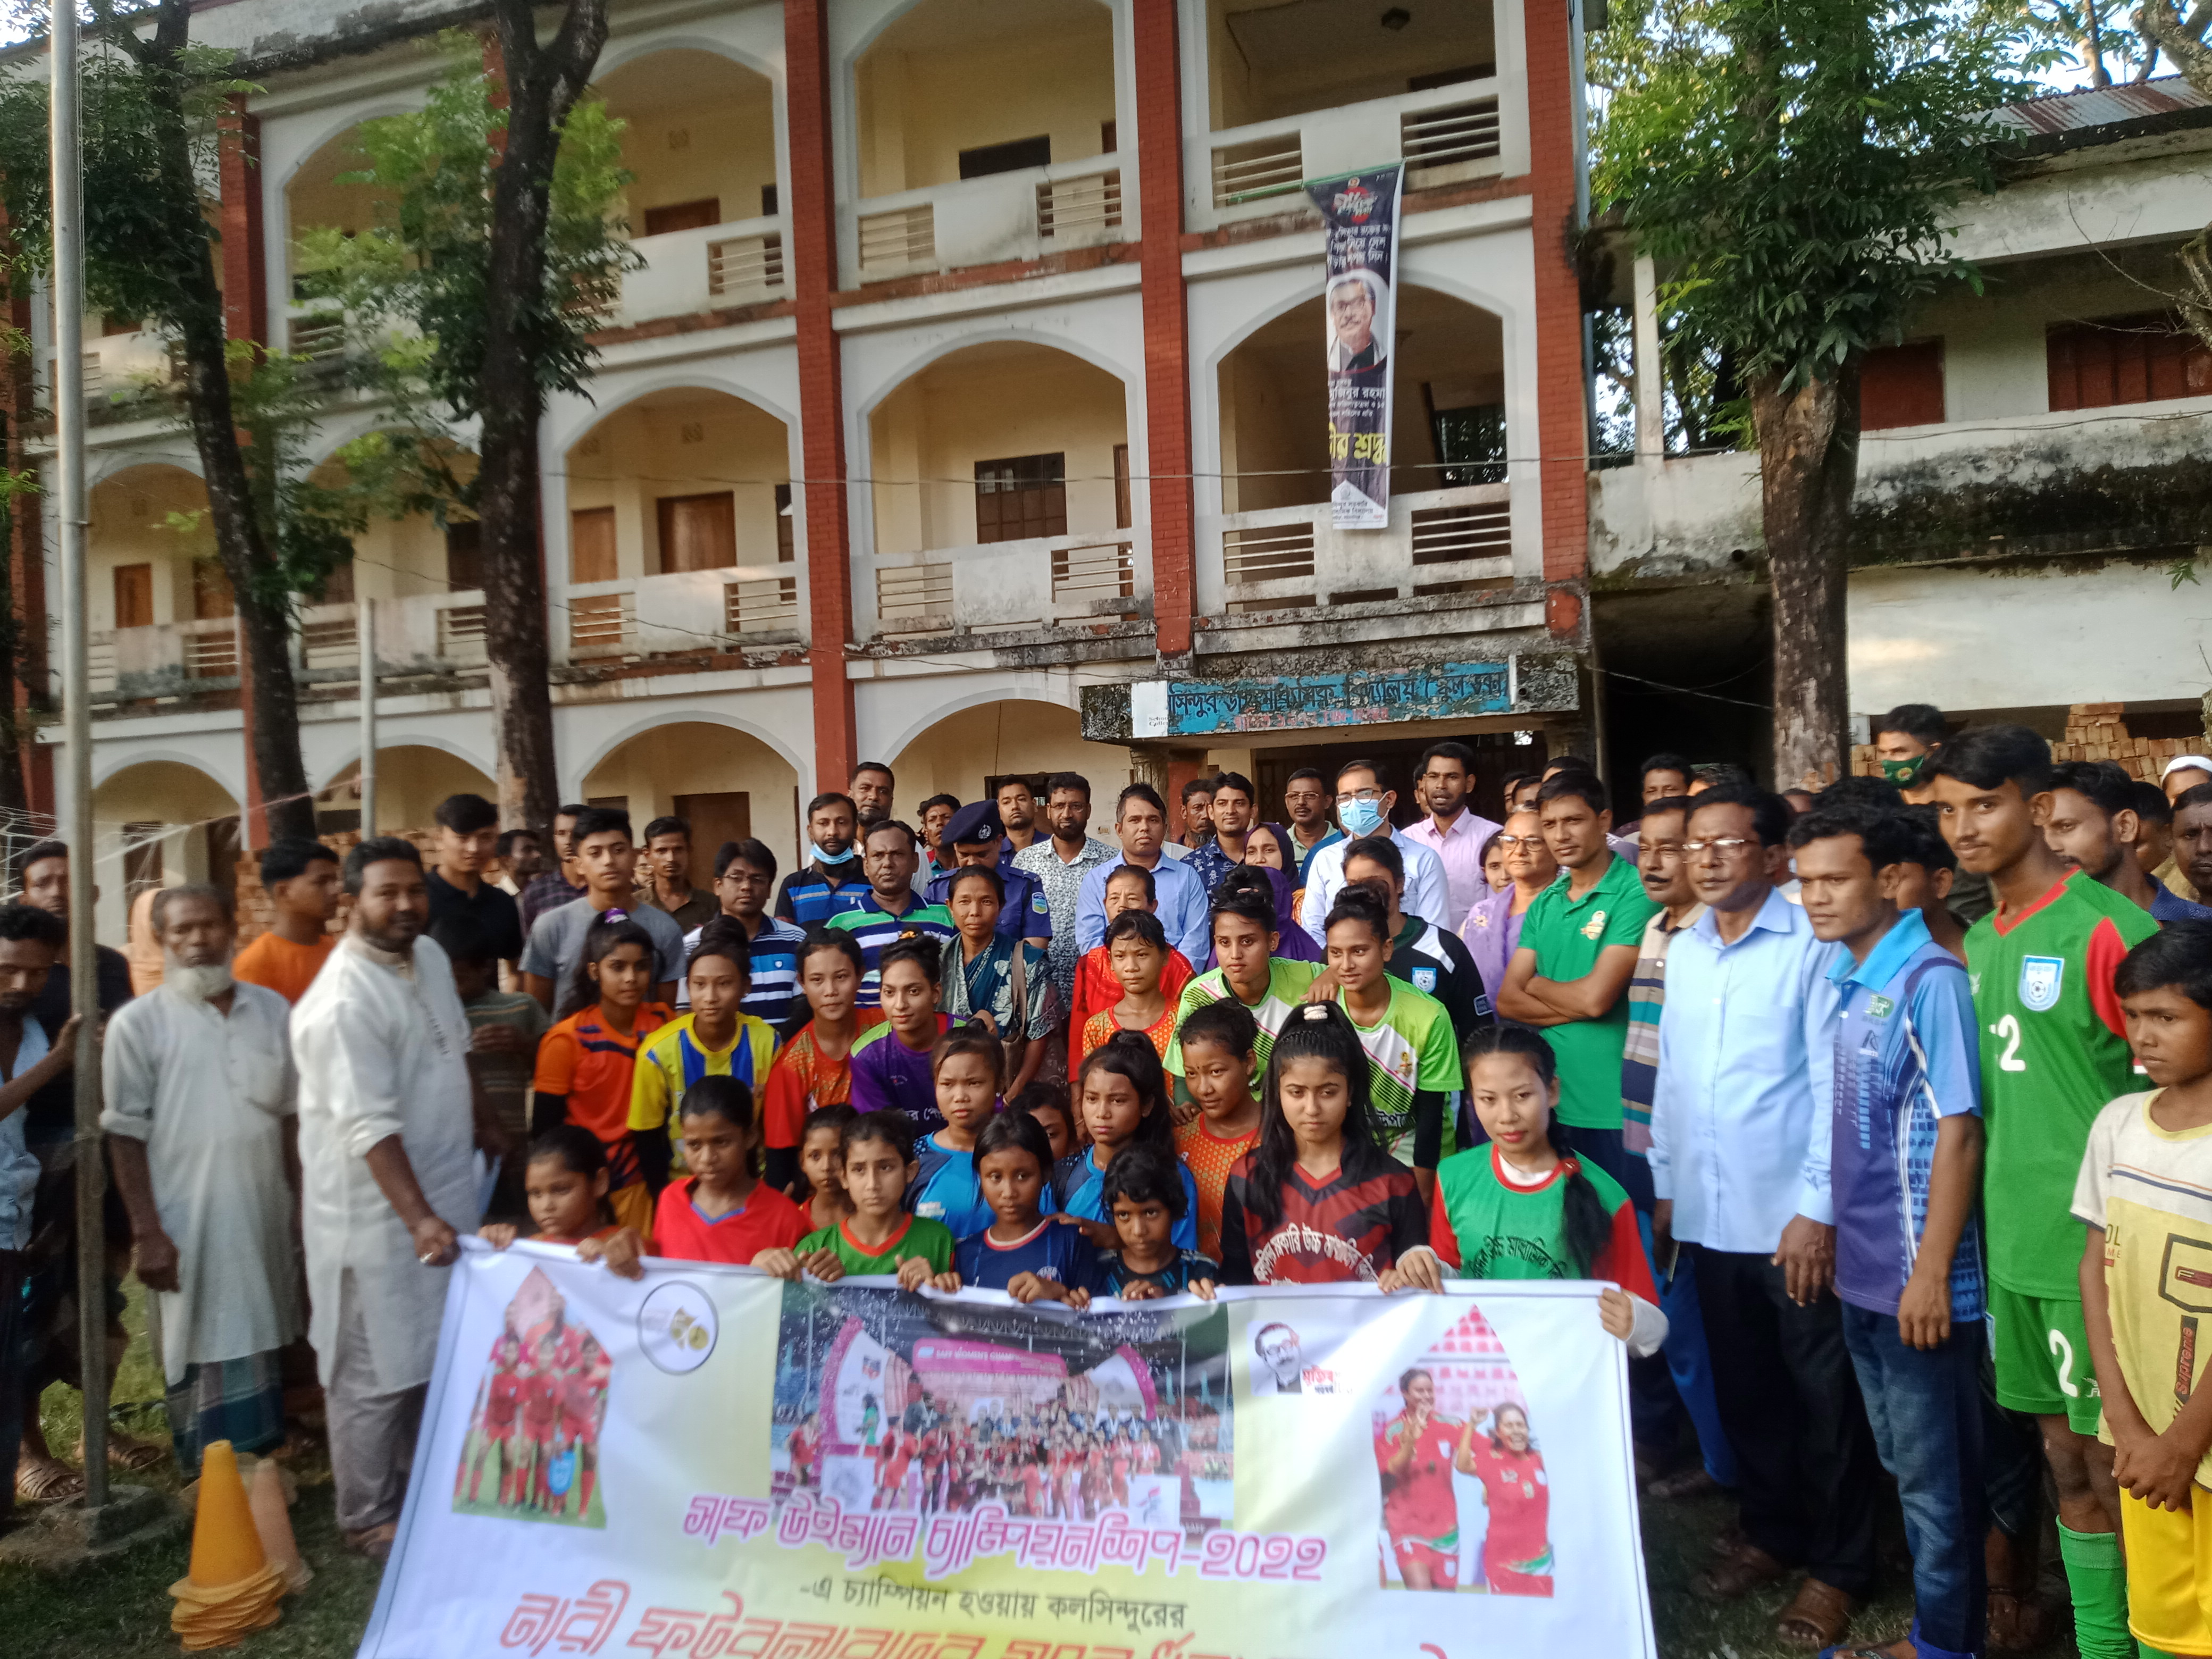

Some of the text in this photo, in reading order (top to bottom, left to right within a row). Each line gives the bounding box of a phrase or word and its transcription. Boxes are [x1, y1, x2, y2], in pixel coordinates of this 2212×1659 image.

[1998, 1014, 2026, 1071] 2
[2049, 1329, 2078, 1398] 2
[683, 1495, 772, 1545] সাফ
[500, 1579, 631, 1658] নারী
